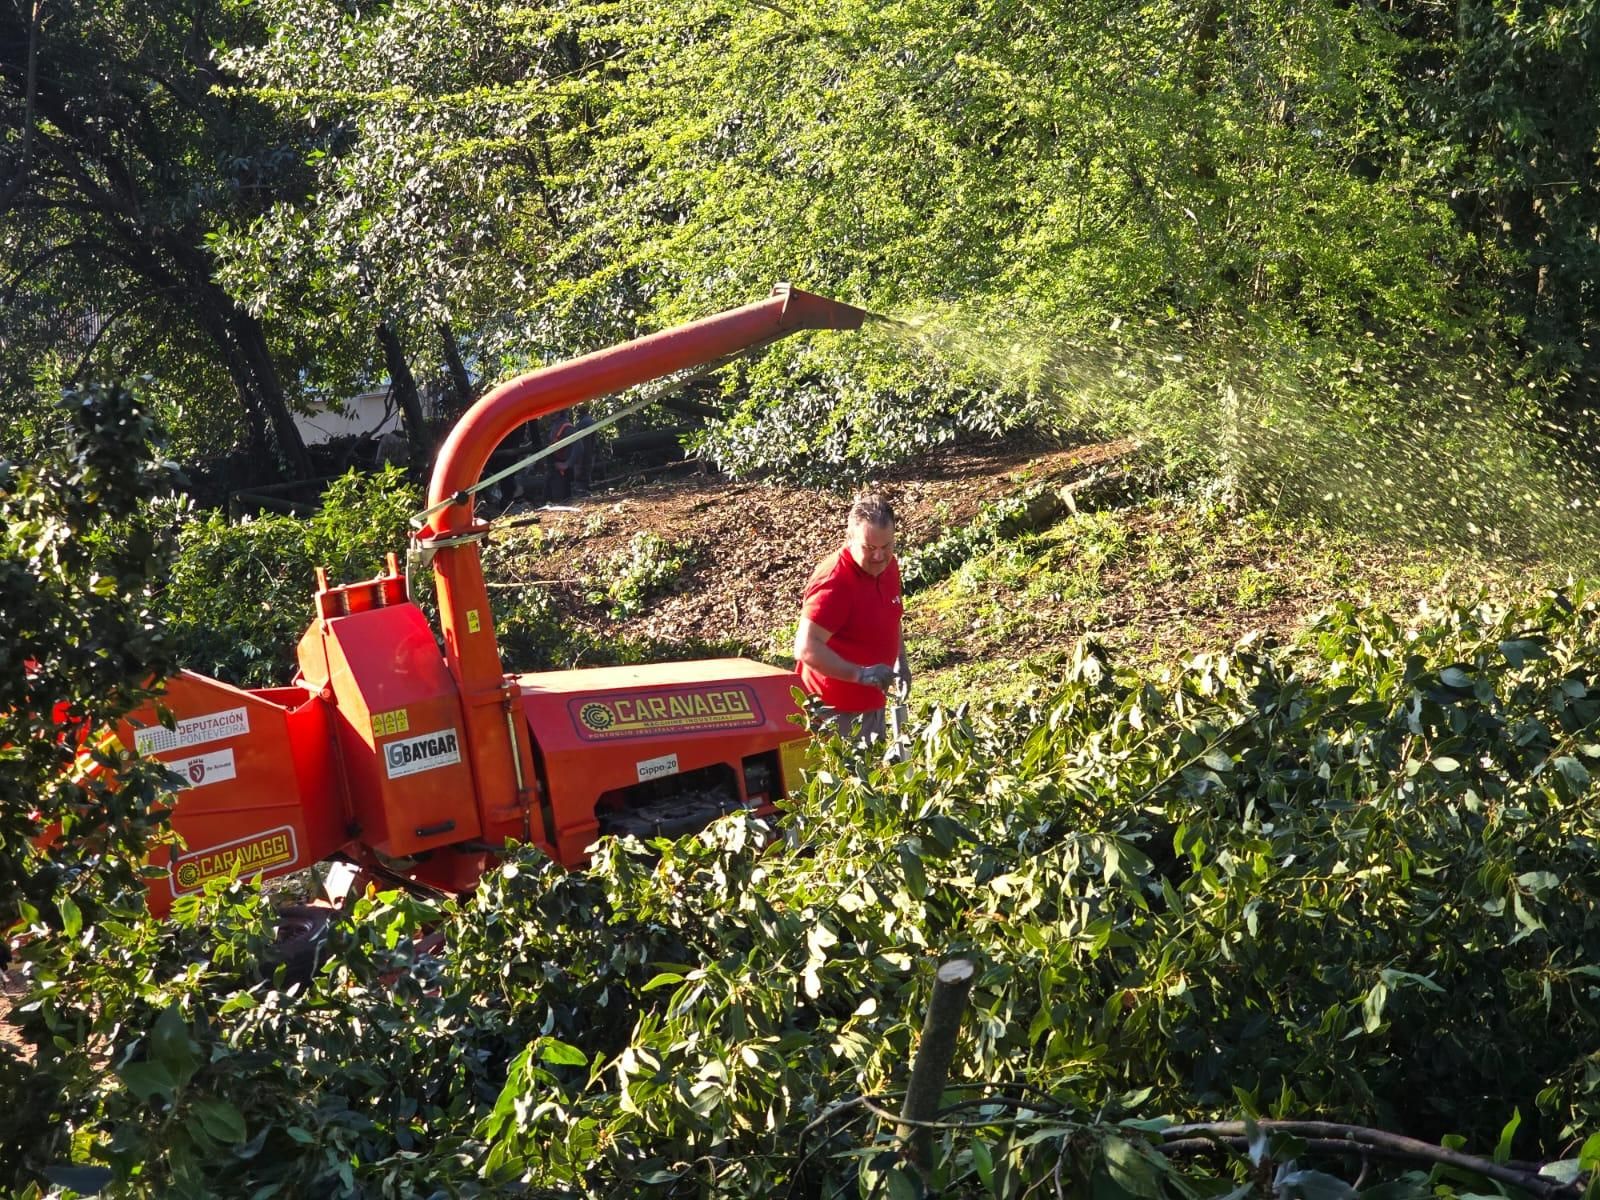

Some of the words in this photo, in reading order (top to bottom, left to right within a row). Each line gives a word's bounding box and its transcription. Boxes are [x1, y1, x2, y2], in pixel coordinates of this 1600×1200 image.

[614, 690, 750, 722] CARAVAGGI
[179, 712, 244, 735] DEPUTACIÓN
[179, 723, 247, 744] PONTEVEDRA
[402, 733, 457, 763] BAYGAR
[639, 763, 665, 777] Cippo
[666, 760, 677, 770] 20
[201, 834, 289, 876] CARAVAGGI
